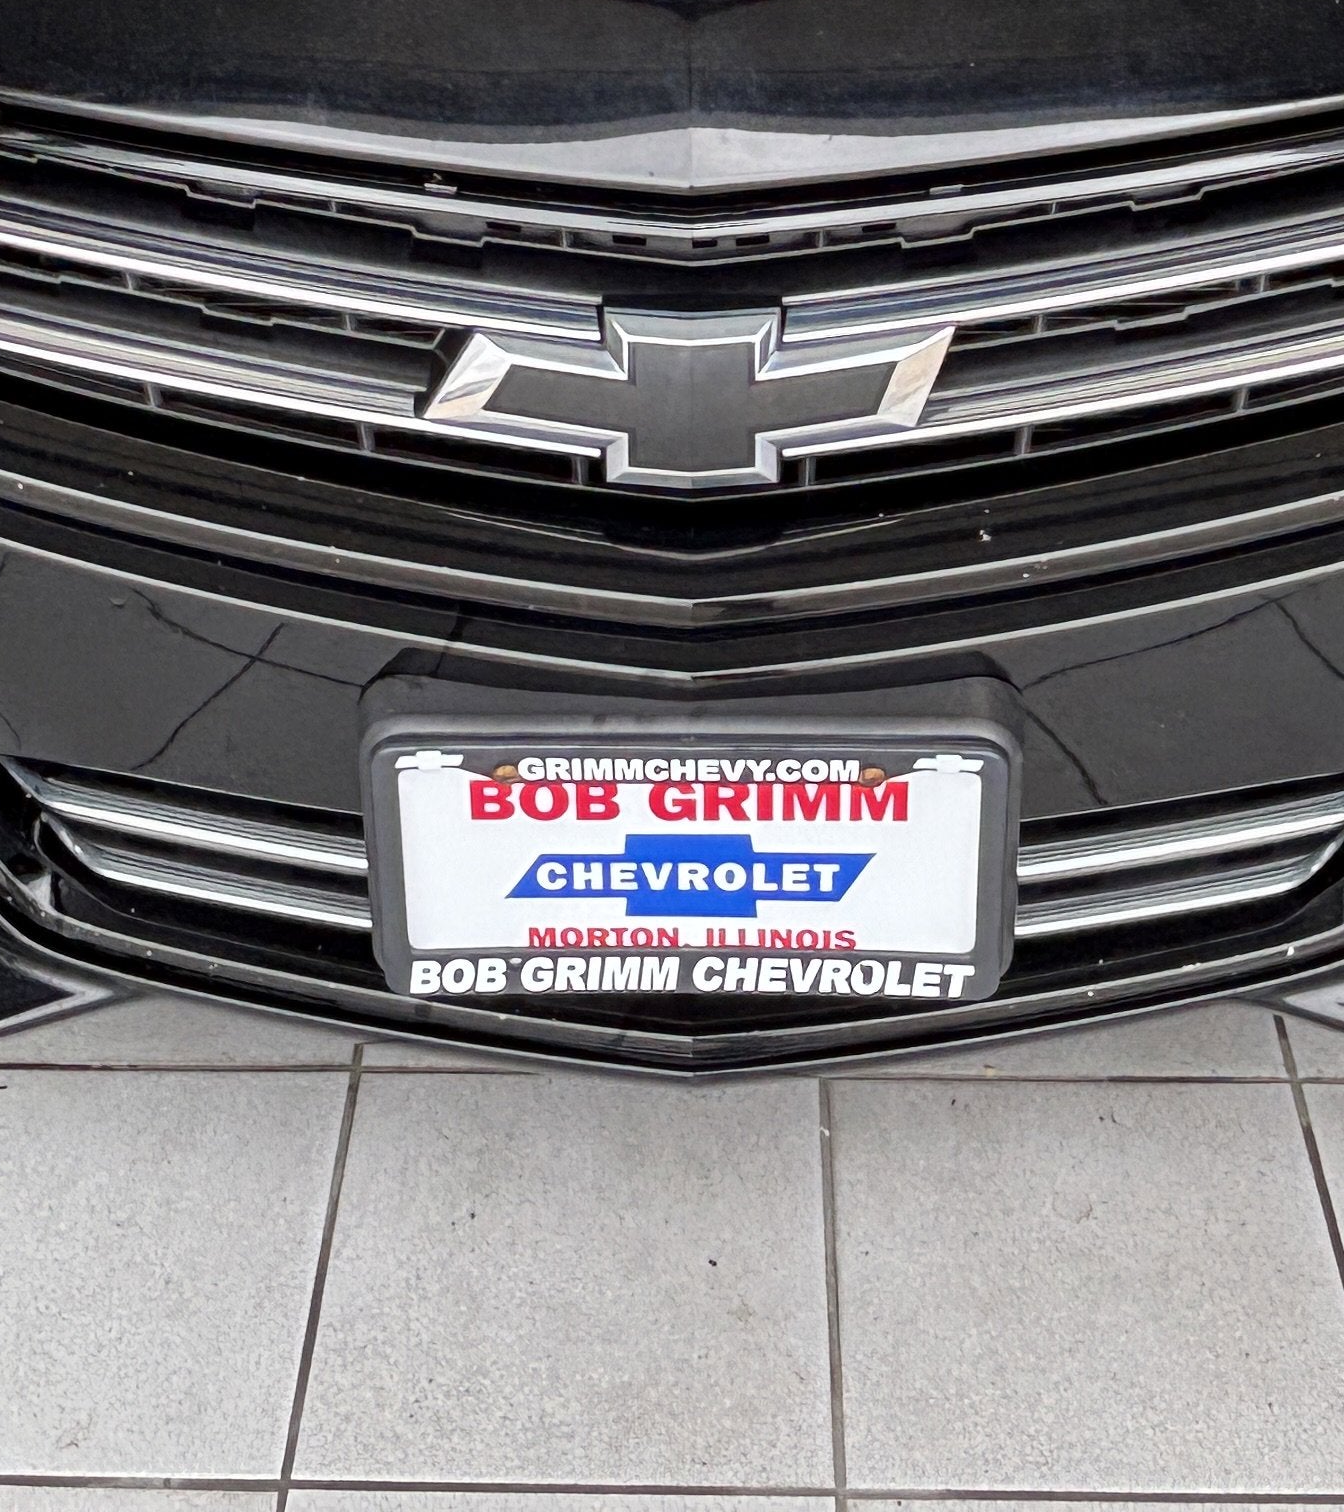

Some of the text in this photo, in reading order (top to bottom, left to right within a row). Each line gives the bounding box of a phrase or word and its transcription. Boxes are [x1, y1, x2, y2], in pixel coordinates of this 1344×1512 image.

[516, 756, 861, 783] GRIMMCHEVY.COM
[469, 779, 909, 822] BOB GRIMM
[535, 861, 842, 895] CHEVROLET
[705, 927, 857, 951] ILLINOIS
[409, 955, 976, 999] BOB GRIMM CHEVROLET
